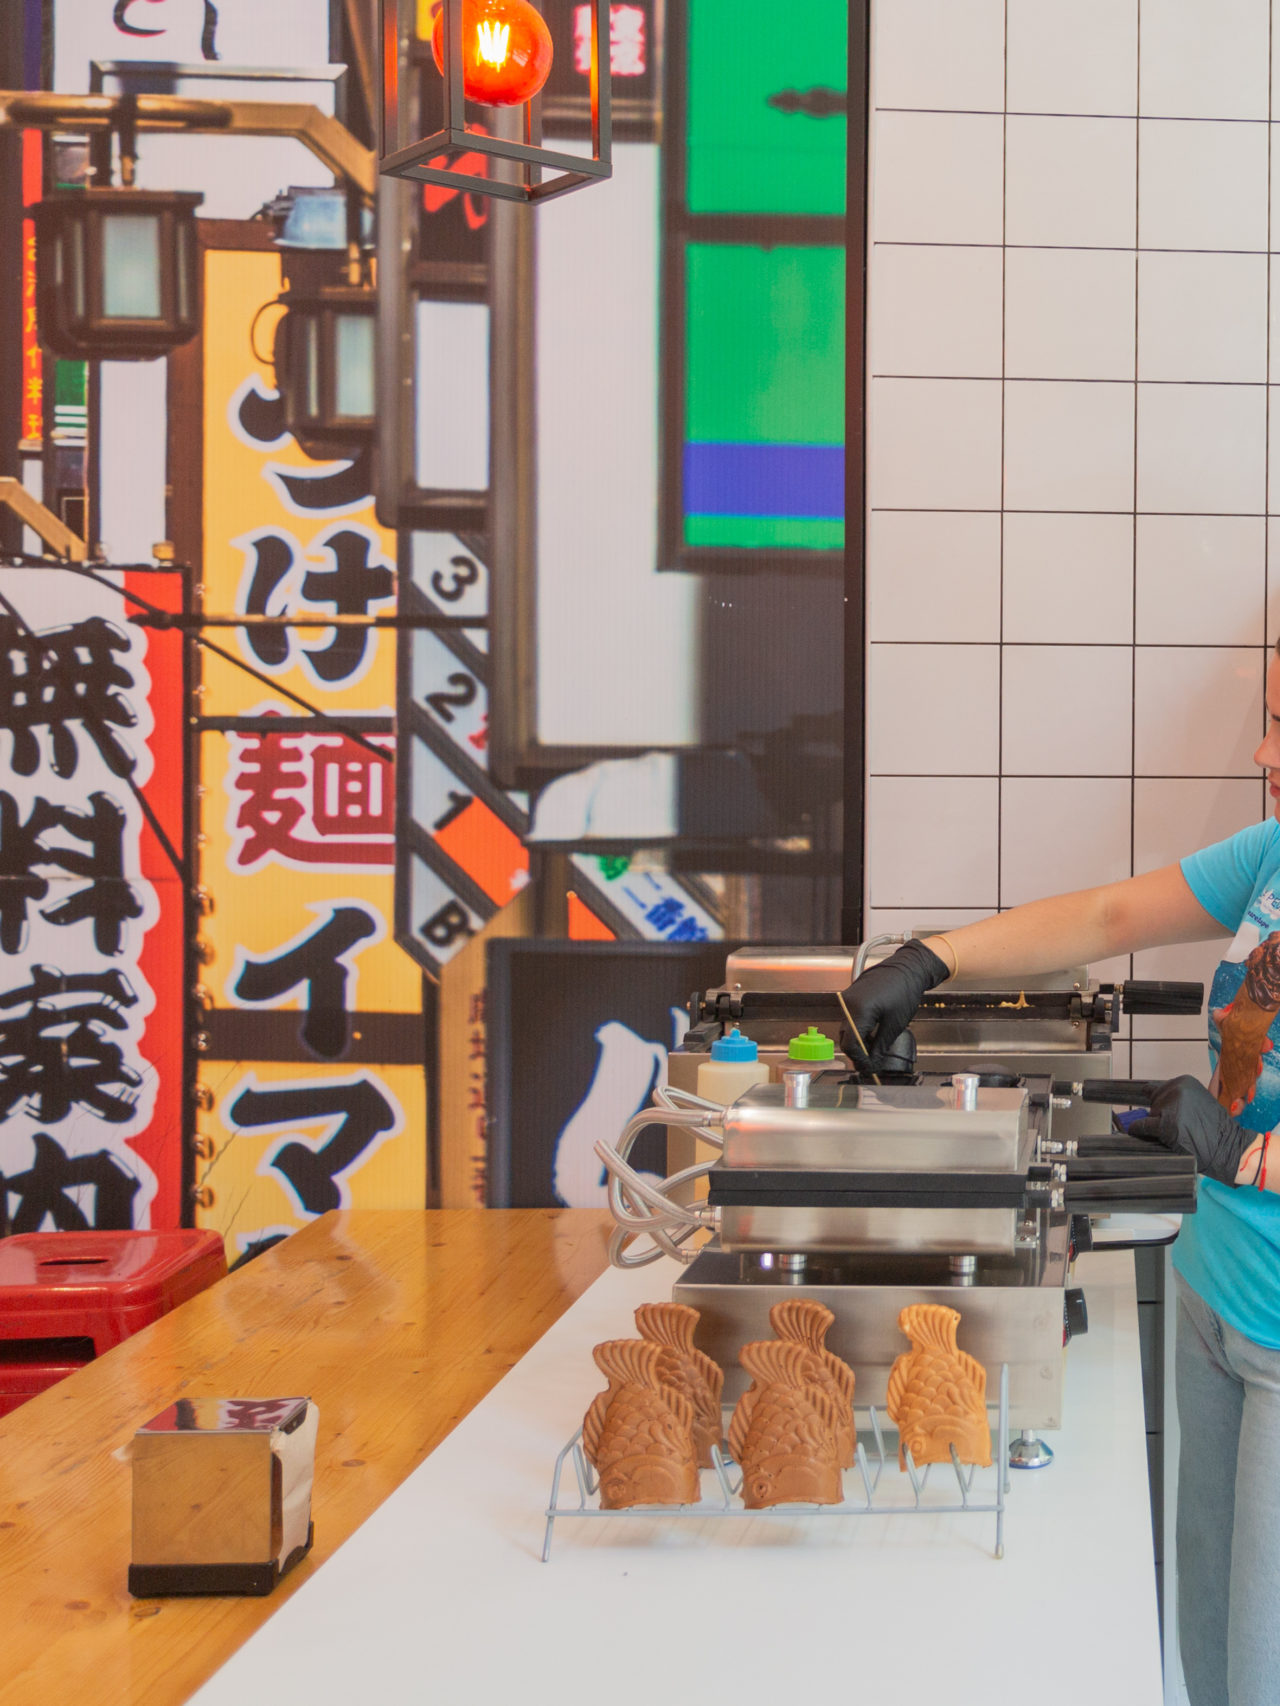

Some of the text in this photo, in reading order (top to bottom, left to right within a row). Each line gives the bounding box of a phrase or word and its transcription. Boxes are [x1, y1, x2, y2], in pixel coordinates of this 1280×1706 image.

[431, 555, 478, 602] 3
[424, 672, 477, 723] 2
[418, 898, 476, 948] B
